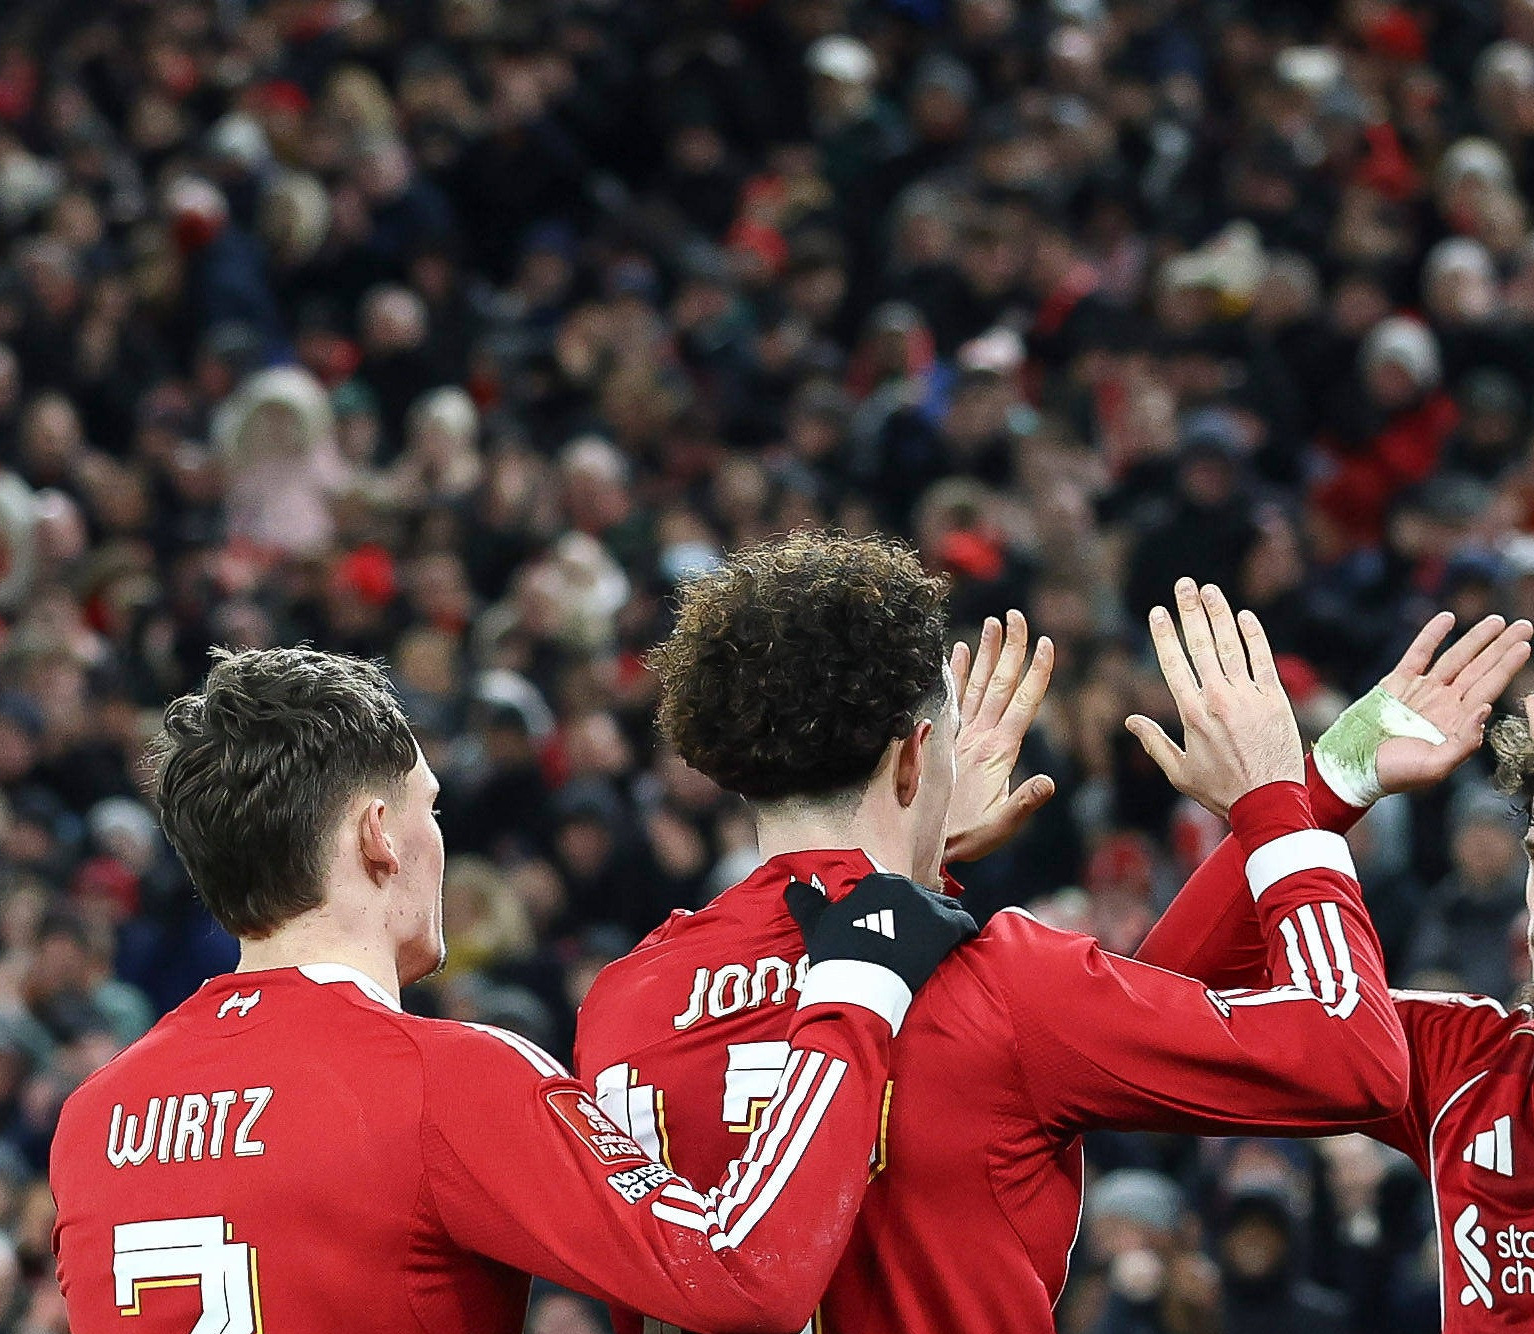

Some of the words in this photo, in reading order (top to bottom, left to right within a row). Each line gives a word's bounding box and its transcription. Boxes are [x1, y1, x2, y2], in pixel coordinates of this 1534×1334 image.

[673, 954, 810, 1030] JON
[107, 1086, 274, 1168] WIRTZ
[599, 1144, 622, 1157] FA
[607, 1172, 639, 1192] No
[633, 1163, 665, 1178] roo
